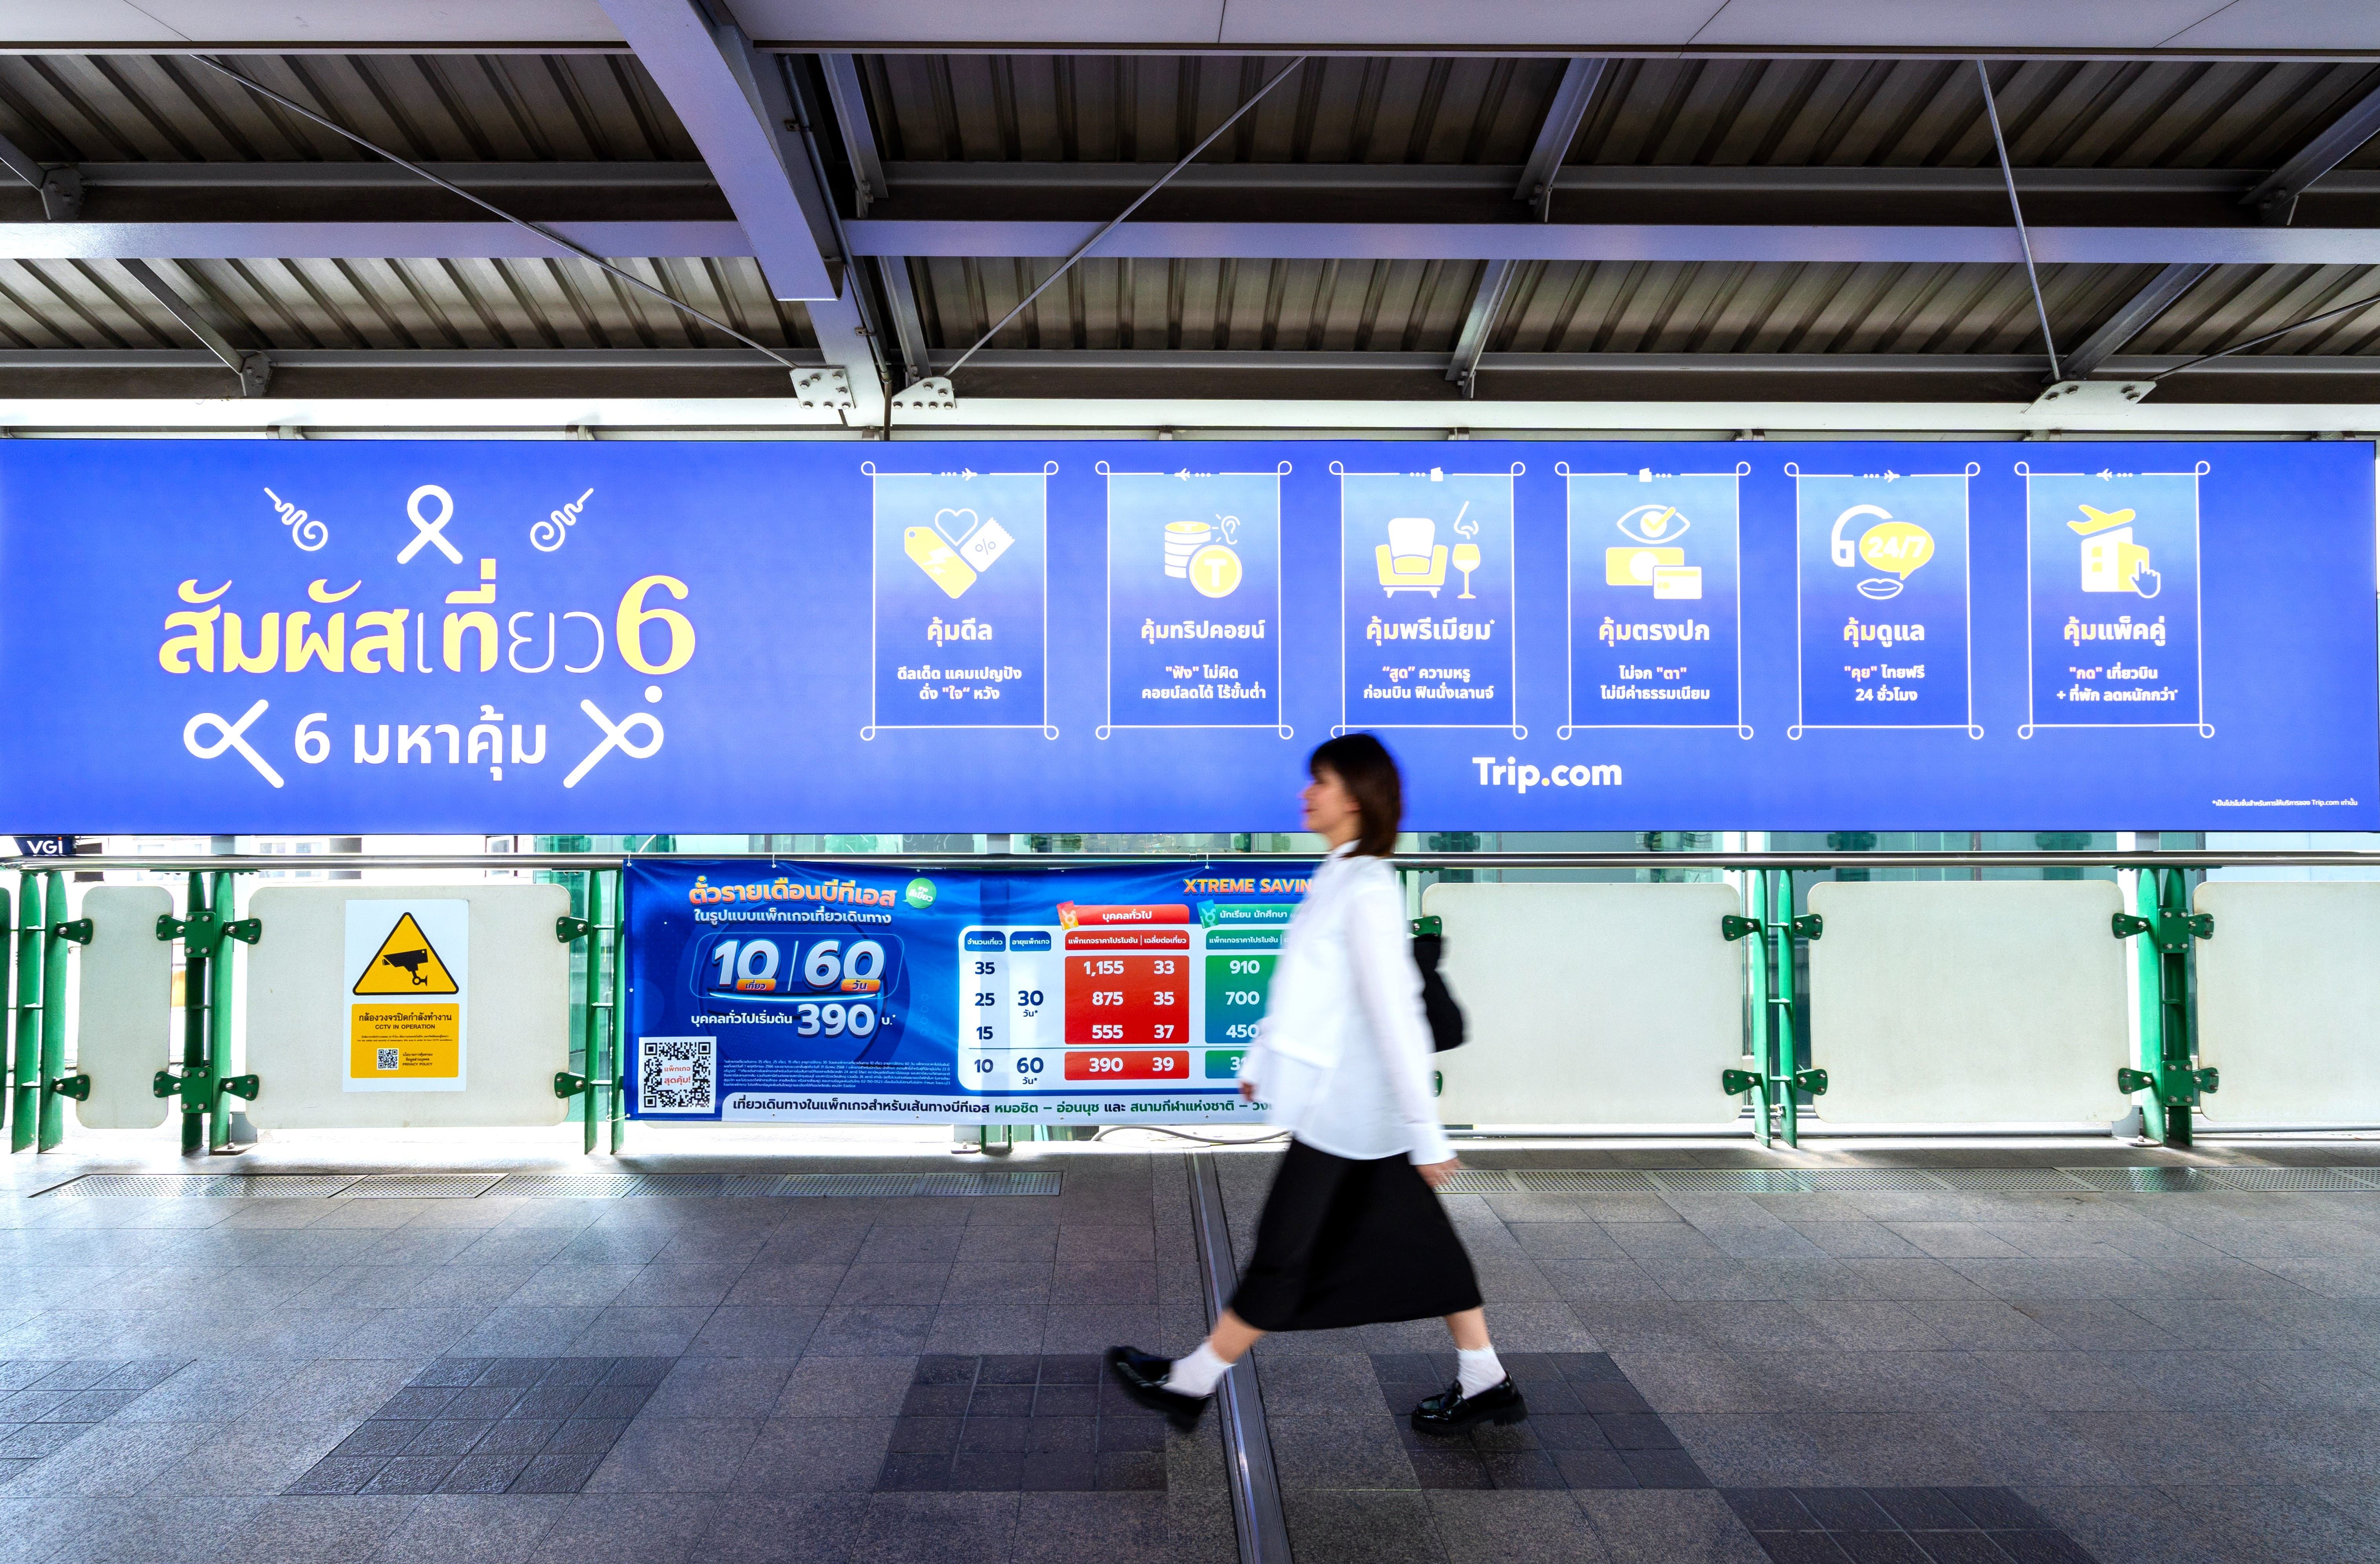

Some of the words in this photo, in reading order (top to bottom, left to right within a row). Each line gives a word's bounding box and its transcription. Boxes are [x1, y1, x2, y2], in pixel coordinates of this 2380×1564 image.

[975, 538, 996, 555] %
[1868, 535, 1927, 559] 24/7
[1204, 559, 1227, 587] T
[927, 616, 992, 647] คุ้มดีล
[1141, 618, 1265, 645] คุ้มทริปคอยน์
[1599, 616, 1710, 647] คุ้มตรงปก
[1844, 617, 1925, 648] คุ้มดูแล
[2064, 615, 2165, 646] คุ้มแพ็คคู่
[897, 665, 941, 680] ดีลเด็ด
[945, 666, 1022, 682] แคมเปญปัง
[1203, 664, 1238, 679] ไม่ผิด
[1419, 668, 1471, 685] ความหรู
[1619, 665, 1652, 679] ไม่จก
[1656, 667, 1687, 679] "ตา"
[1844, 666, 1877, 682] "คุย"
[1880, 664, 1925, 679] ไทยฟรี
[2107, 662, 2158, 679] เที่ยวบิน
[919, 683, 938, 699] ดั่ง
[974, 686, 1000, 699] หวัง
[1142, 684, 1213, 699] คอยน์ลดได้
[1217, 681, 1266, 699] ไร้ขั้นต่ำ
[1364, 684, 1411, 699] ก่อนบิน
[1415, 682, 1494, 699] ฟินนั่งเลานจ์
[1600, 685, 1710, 699] ไม่มีค่าธรรมเนียม
[1855, 688, 1874, 701] 24
[1877, 684, 1918, 701] ชั่วโมง
[2069, 684, 2100, 701] ที่พัก
[295, 712, 330, 764] 6
[354, 705, 546, 781] มหาคุ้ม
[1472, 756, 1622, 794] Trip.com
[689, 876, 897, 908] ตั๋วรายเดือนบีทีเอส
[1184, 879, 1255, 894] XTREME
[1260, 878, 1312, 894] SAVIN
[694, 906, 892, 926] ในรูปแบบแพ็กเกจเที่ยวเดินทาง
[1102, 909, 1152, 922] บุคคลทั่วไป
[1220, 910, 1251, 918] นักเรียน
[1254, 910, 1287, 918] นักศึกษา
[1012, 937, 1050, 946] อายุแพ็กเกจ
[1068, 936, 1138, 945] แพ็กเกจราคาโปรโมชัน
[1144, 936, 1187, 944] เฉลี่ยต่อเที่ยว
[713, 938, 780, 988] 10
[804, 939, 887, 988] 60
[975, 961, 995, 975] 35
[1084, 961, 1124, 977] 1,155
[1154, 960, 1175, 974] 33
[1229, 960, 1260, 974] 910
[745, 980, 766, 990] เที่ยว
[852, 980, 867, 990] วัน
[975, 992, 995, 1006] 25
[1018, 990, 1044, 1006] 30
[1092, 991, 1124, 1005] 875
[1154, 991, 1175, 1005] 35
[1225, 991, 1260, 1005] 700
[359, 1012, 452, 1021] กล้องวงจรปิดกำลังทำงาน
[691, 1005, 793, 1027] บุคคลทั่วไปเริ่มต้น
[796, 1003, 875, 1037] 390
[976, 1026, 993, 1040] 15
[1092, 1025, 1123, 1039] 555
[1154, 1024, 1174, 1038] 37
[1226, 1024, 1260, 1038] 450
[974, 1059, 993, 1073] 10
[1016, 1057, 1044, 1074] 60
[1089, 1057, 1123, 1072] 390
[1153, 1057, 1174, 1071] 39
[664, 1076, 691, 1086] สุดคุ้ม!
[733, 1095, 989, 1114] เที่ยวเดินทางในแพ็กเกจสำหรับเส้นทางบีทีเอส
[995, 1102, 1038, 1114] หมอชิต
[1056, 1102, 1099, 1116] อ่อนนุช
[1104, 1104, 1126, 1112] และ
[1130, 1100, 1234, 1112] สนามกีฬาแห่งชาติ
